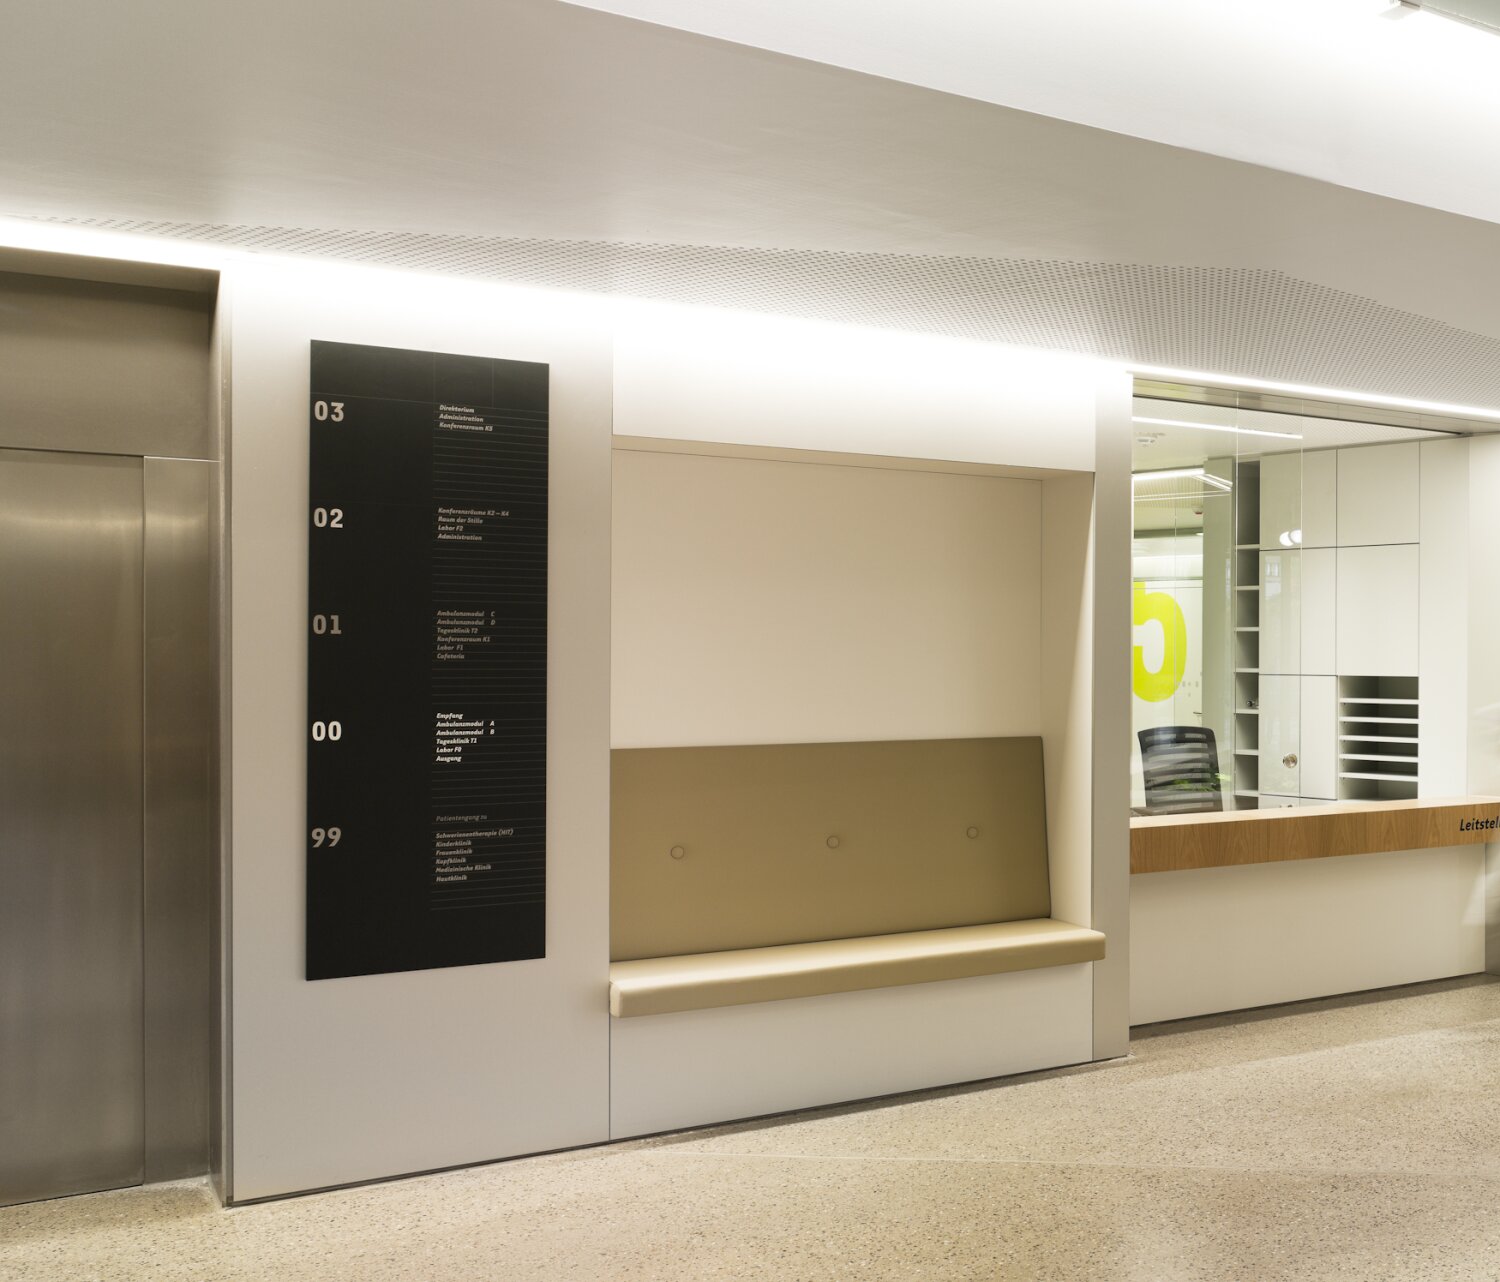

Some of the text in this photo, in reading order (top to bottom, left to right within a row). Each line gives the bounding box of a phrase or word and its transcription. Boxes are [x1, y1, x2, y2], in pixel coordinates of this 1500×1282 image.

[314, 400, 345, 422] 03
[439, 404, 475, 413] Direktorium
[439, 413, 484, 423] Administration
[439, 422, 484, 431] Konferenzraum
[313, 507, 344, 529] 02
[437, 533, 482, 541] Administration
[312, 614, 342, 635] 01
[437, 627, 470, 635] Tagesklinik
[436, 636, 482, 644] Konferenzraum
[436, 653, 465, 661] Cafeteria
[436, 712, 464, 720] Empfang
[436, 720, 484, 728] Ambulanzmodul
[311, 720, 342, 742] 00
[436, 738, 470, 746] Tagesklinik
[436, 755, 462, 763] Ausgang
[311, 826, 342, 848] 99
[436, 840, 472, 848] Kinderklinik
